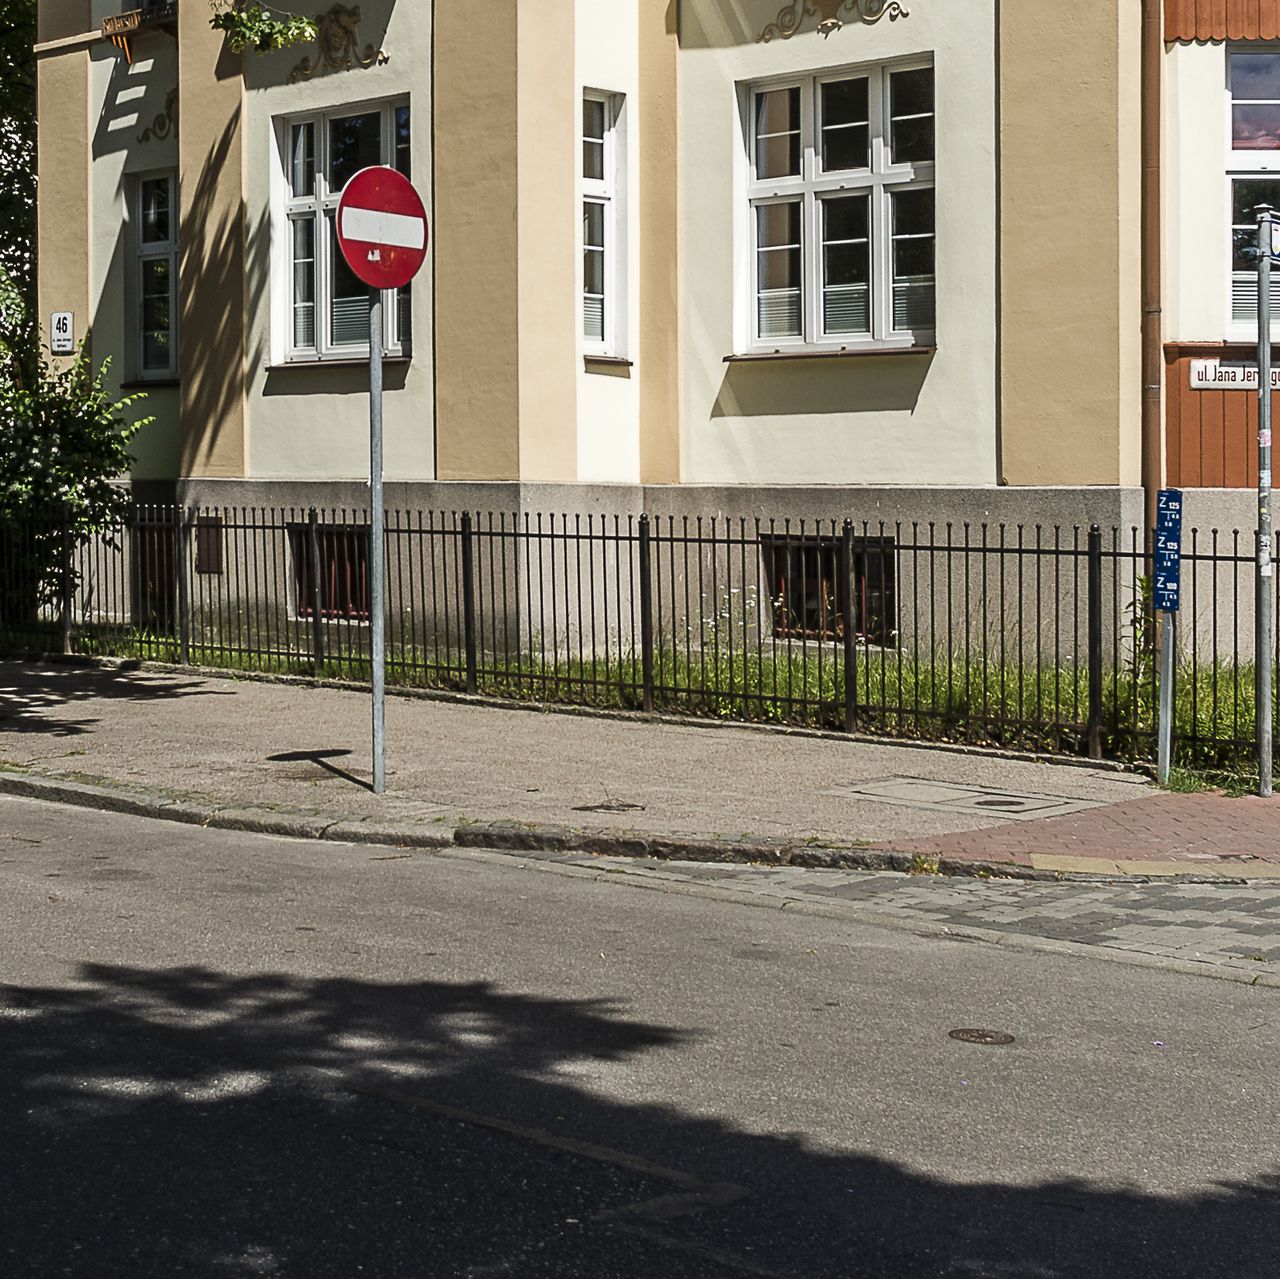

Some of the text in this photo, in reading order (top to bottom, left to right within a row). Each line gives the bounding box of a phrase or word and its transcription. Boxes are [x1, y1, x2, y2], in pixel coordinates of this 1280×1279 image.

[55, 316, 68, 334] 46
[1197, 365, 1210, 382] ul.
[1212, 365, 1237, 382] Jana
[1159, 496, 1167, 508] Z
[1157, 536, 1166, 548] Z
[1156, 576, 1165, 588] Z
